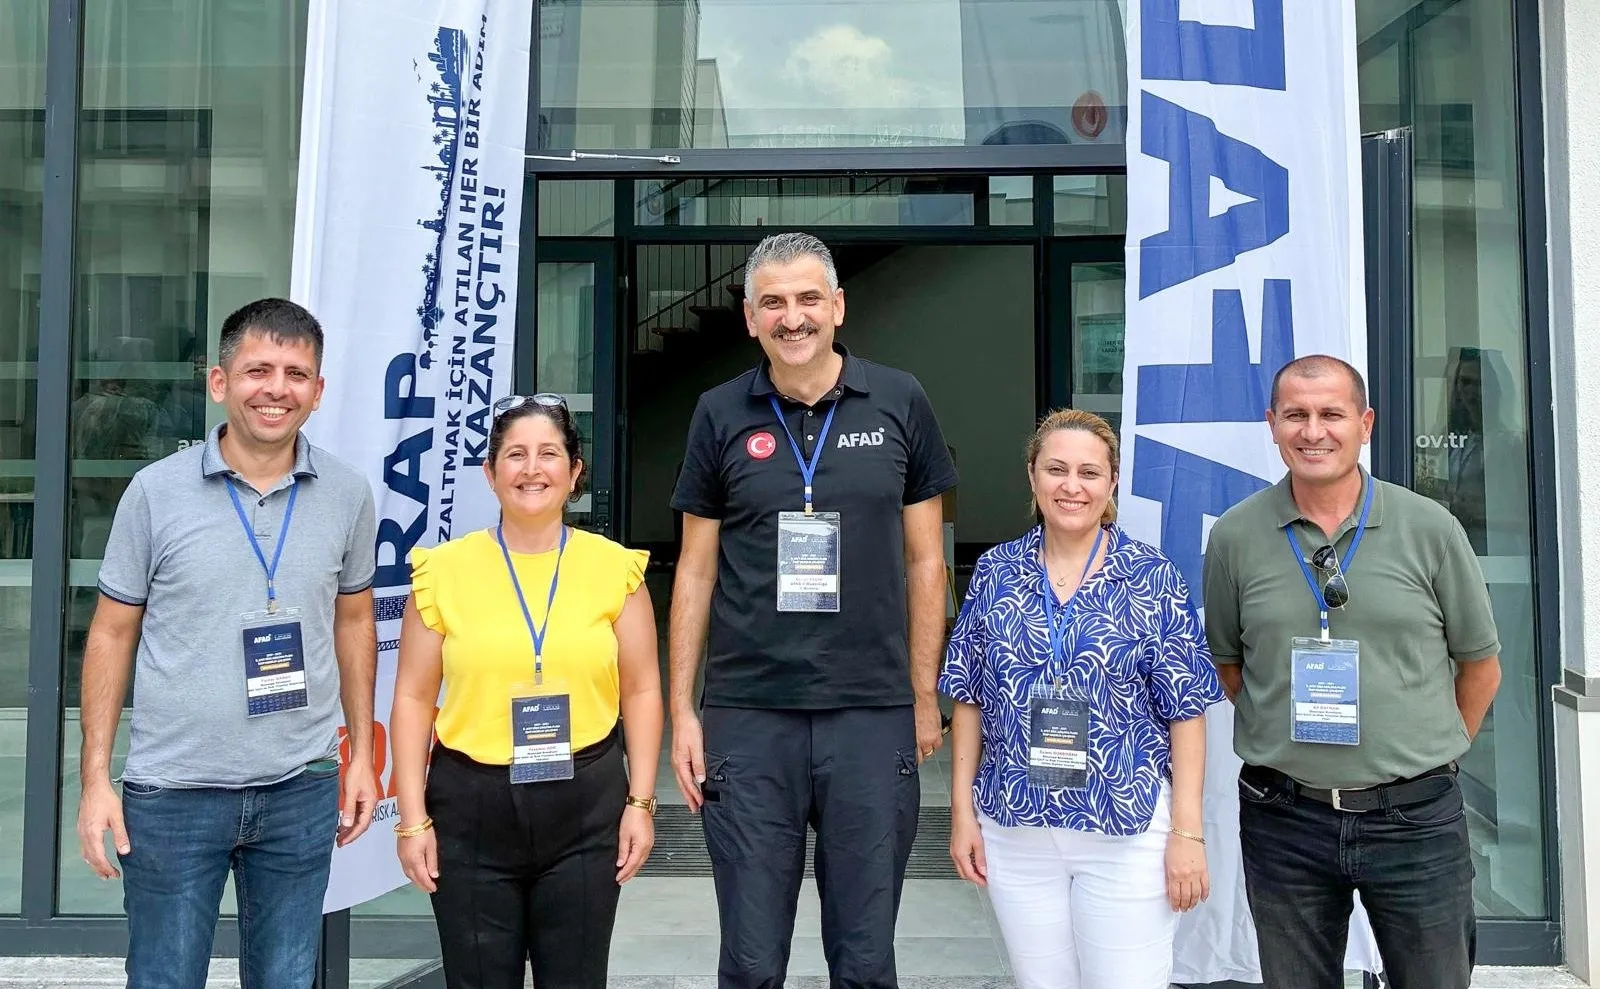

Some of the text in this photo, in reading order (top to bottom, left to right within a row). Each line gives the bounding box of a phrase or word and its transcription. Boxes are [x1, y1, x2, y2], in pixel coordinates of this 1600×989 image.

[472, 14, 488, 91] ADIM
[460, 158, 478, 214] HER
[455, 222, 475, 327] ATILAN
[462, 185, 506, 467] KAZANÇTIR!
[448, 335, 467, 401] İÇİN
[837, 427, 885, 449] AFAD
